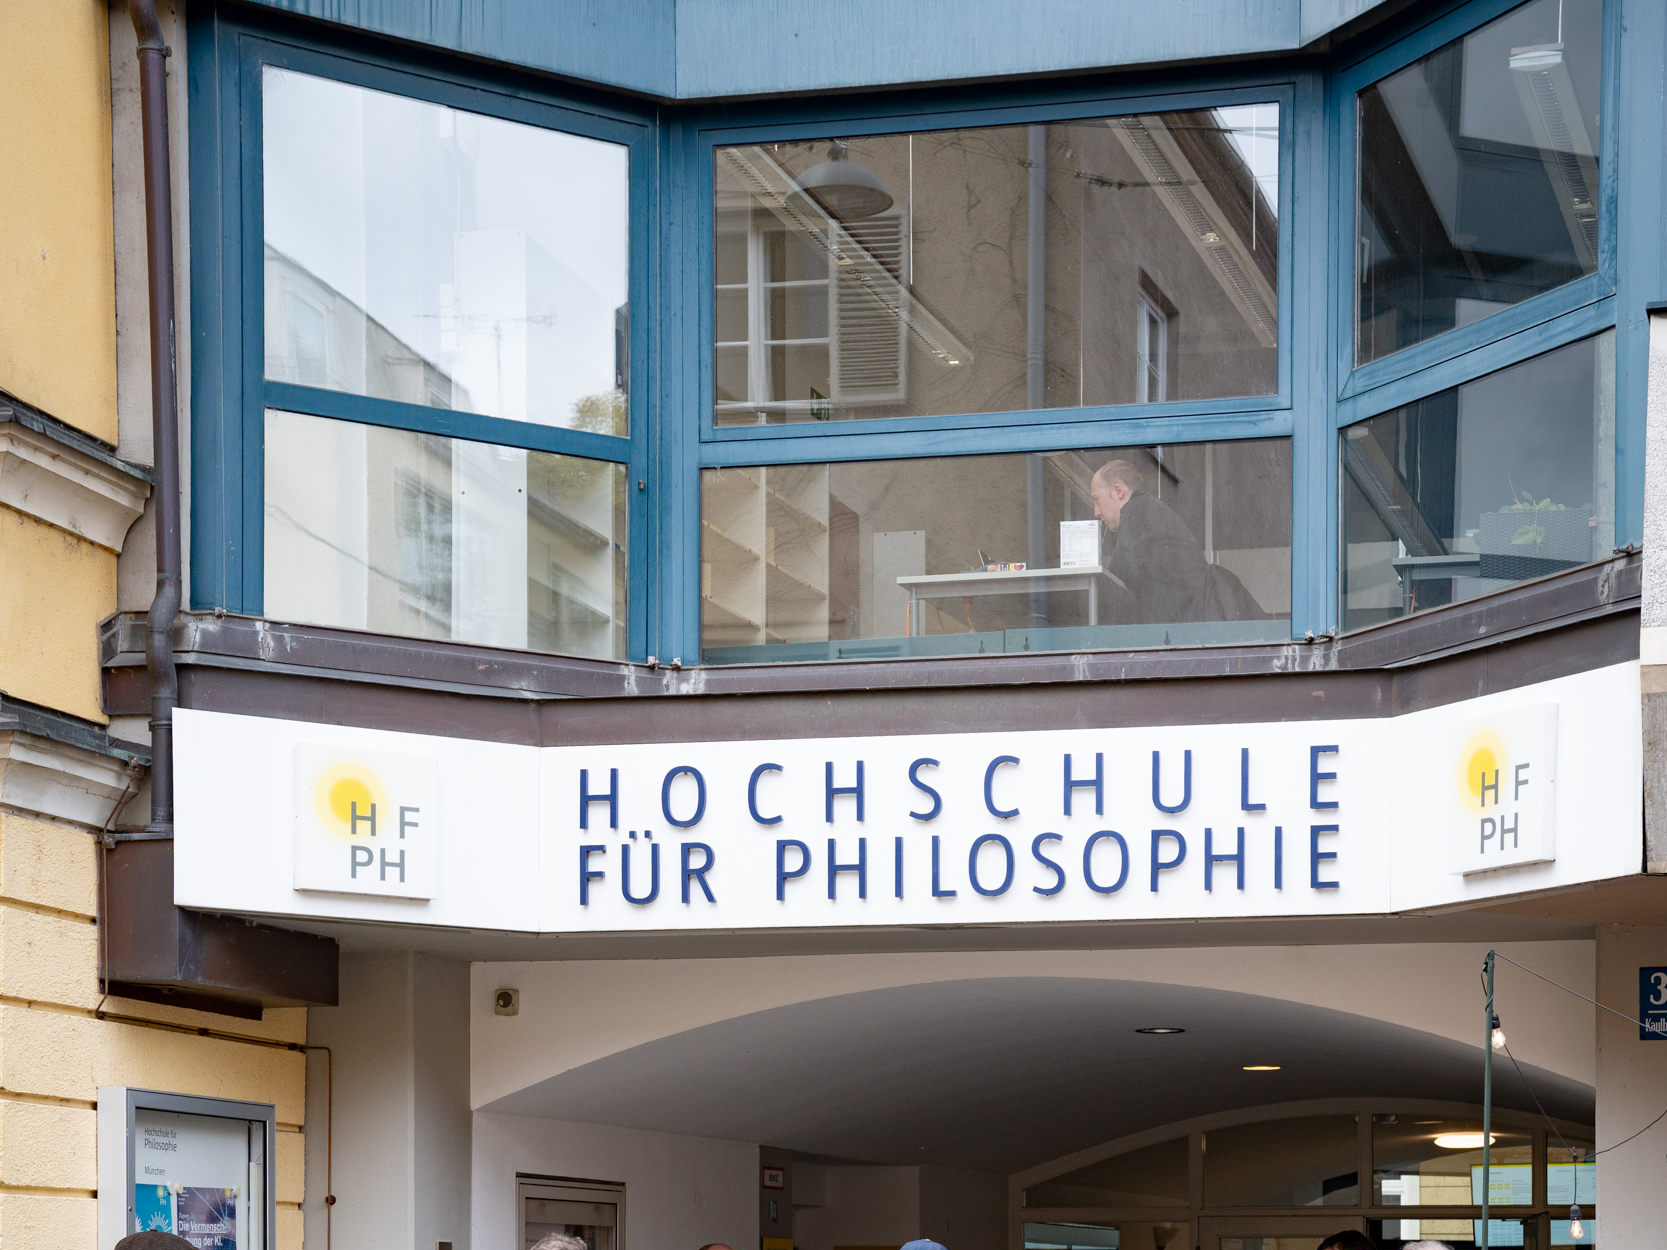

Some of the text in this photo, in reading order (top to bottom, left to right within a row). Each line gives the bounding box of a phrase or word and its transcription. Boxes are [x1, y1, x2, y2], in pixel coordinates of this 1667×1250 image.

[579, 744, 1340, 830] HOCHSCHULE
[1480, 812, 1519, 855] PH
[350, 844, 406, 883] PH
[579, 823, 1340, 907] FÜR PHILOSOPHIE
[144, 1126, 178, 1139] Hochschule für
[144, 1138, 178, 1153] Philosophie
[144, 1165, 166, 1176] München
[768, 1173, 779, 1183] BMZ
[160, 1198, 167, 1206] PH
[178, 1220, 227, 1233] Die Vermensch-
[203, 1236, 213, 1246] der
